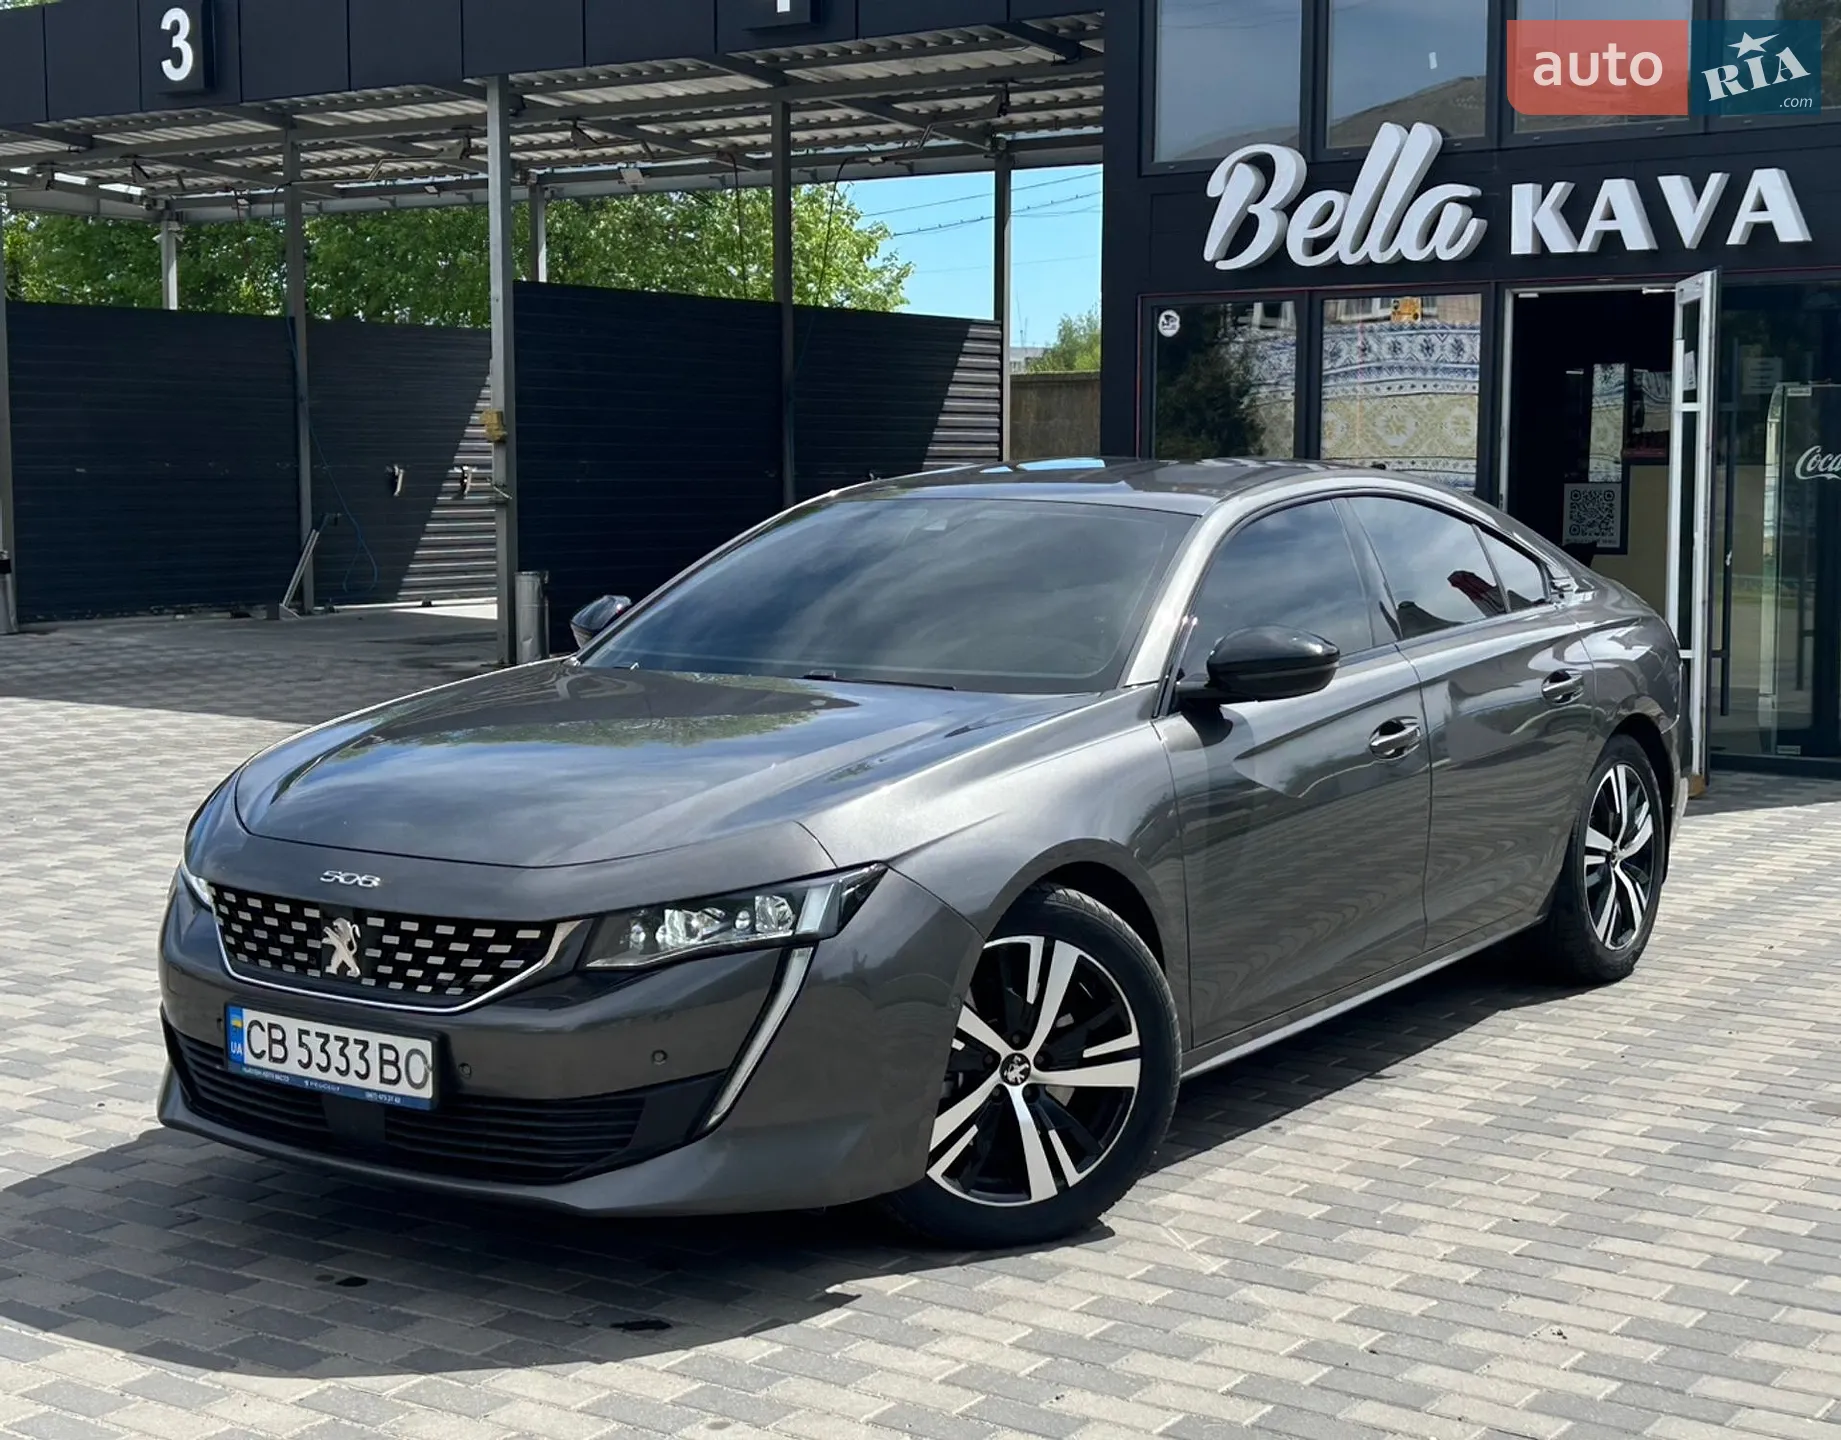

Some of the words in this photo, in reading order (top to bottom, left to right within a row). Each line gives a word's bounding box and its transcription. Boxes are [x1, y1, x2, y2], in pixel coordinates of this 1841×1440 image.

[160, 7, 194, 82] 3
[1203, 121, 1488, 271] Bella
[1510, 168, 1812, 256] KAVA
[1795, 445, 1841, 480] Coca
[230, 1041, 243, 1056] UA
[246, 1019, 288, 1064] CB
[296, 1028, 370, 1081] 5333
